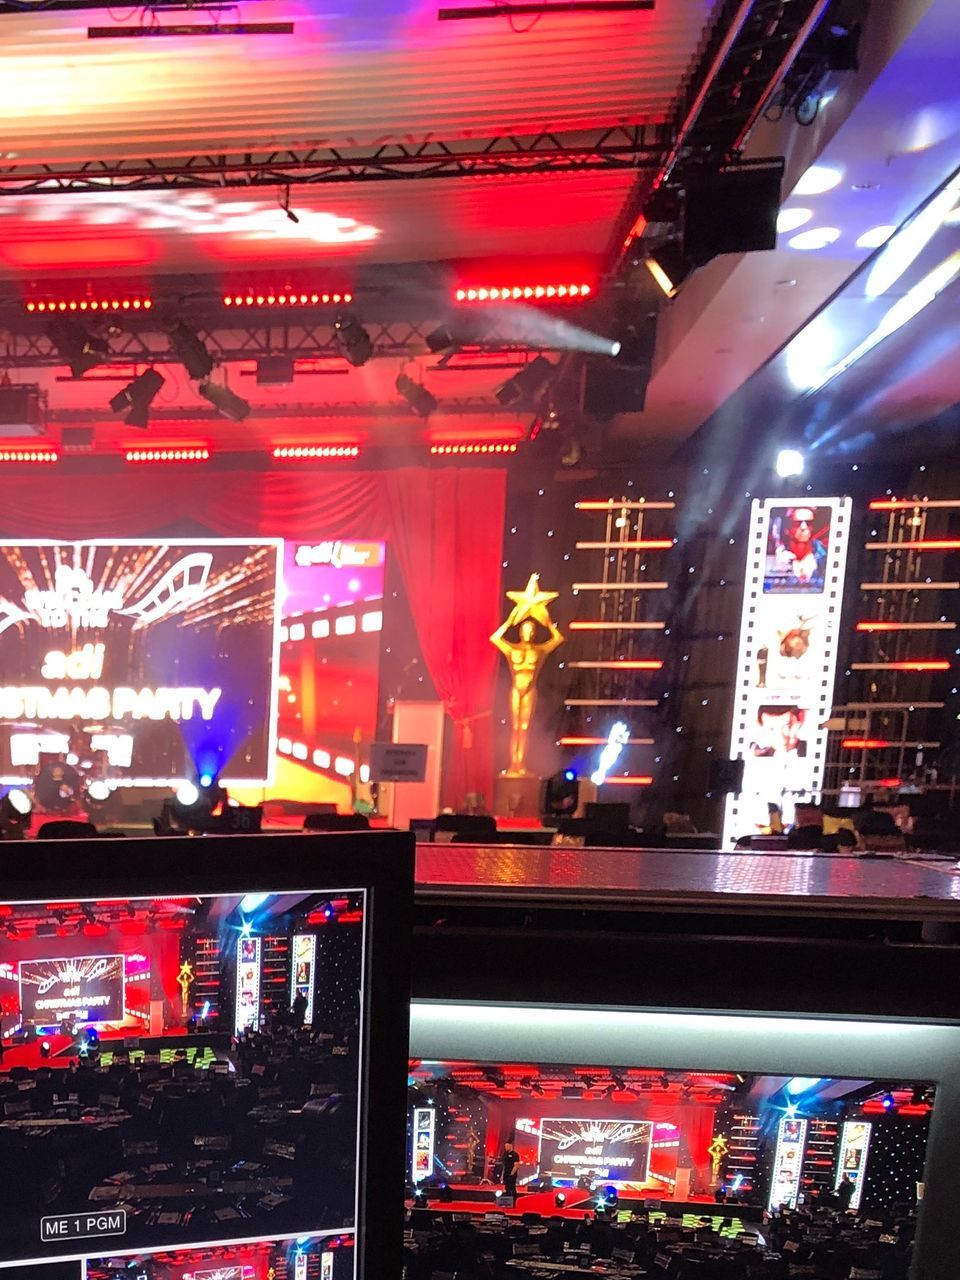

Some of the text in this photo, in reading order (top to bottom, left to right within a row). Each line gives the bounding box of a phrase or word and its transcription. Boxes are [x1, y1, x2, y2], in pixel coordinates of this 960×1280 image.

[45, 1216, 121, 1234] ME 1 PGM
